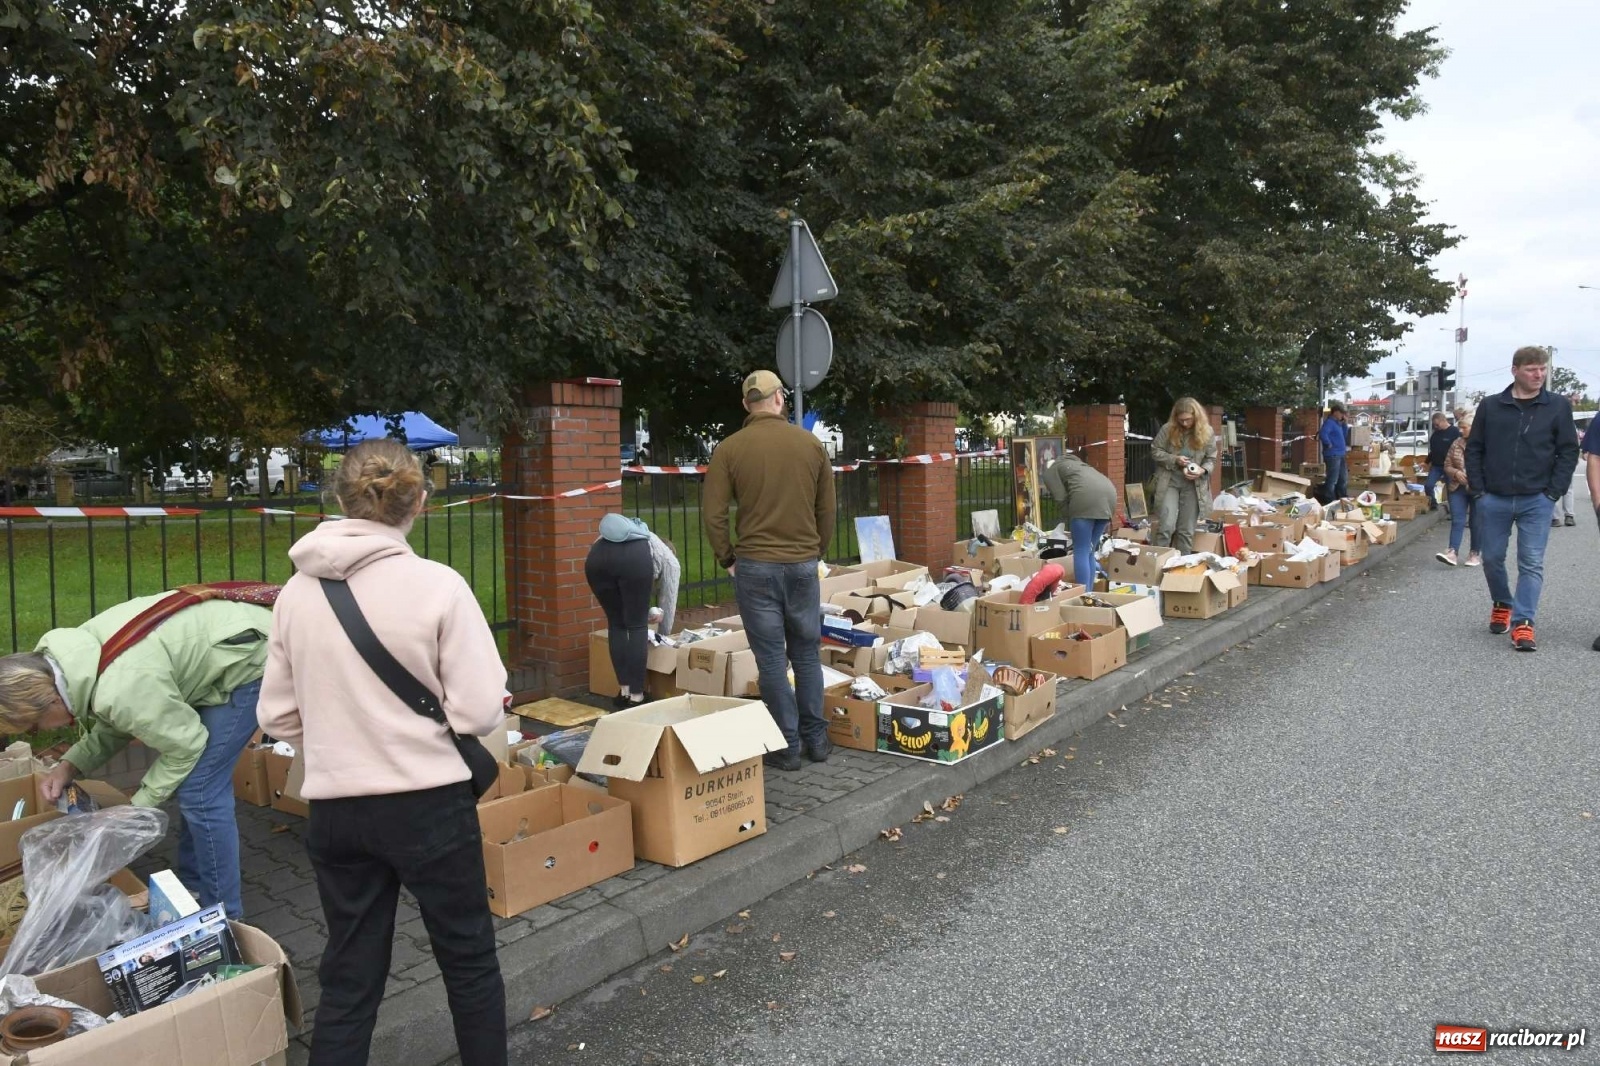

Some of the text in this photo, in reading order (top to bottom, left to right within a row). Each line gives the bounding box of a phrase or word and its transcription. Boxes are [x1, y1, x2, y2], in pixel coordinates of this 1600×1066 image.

[684, 764, 759, 800] BURKHART
[705, 789, 744, 809] 90547 Stein
